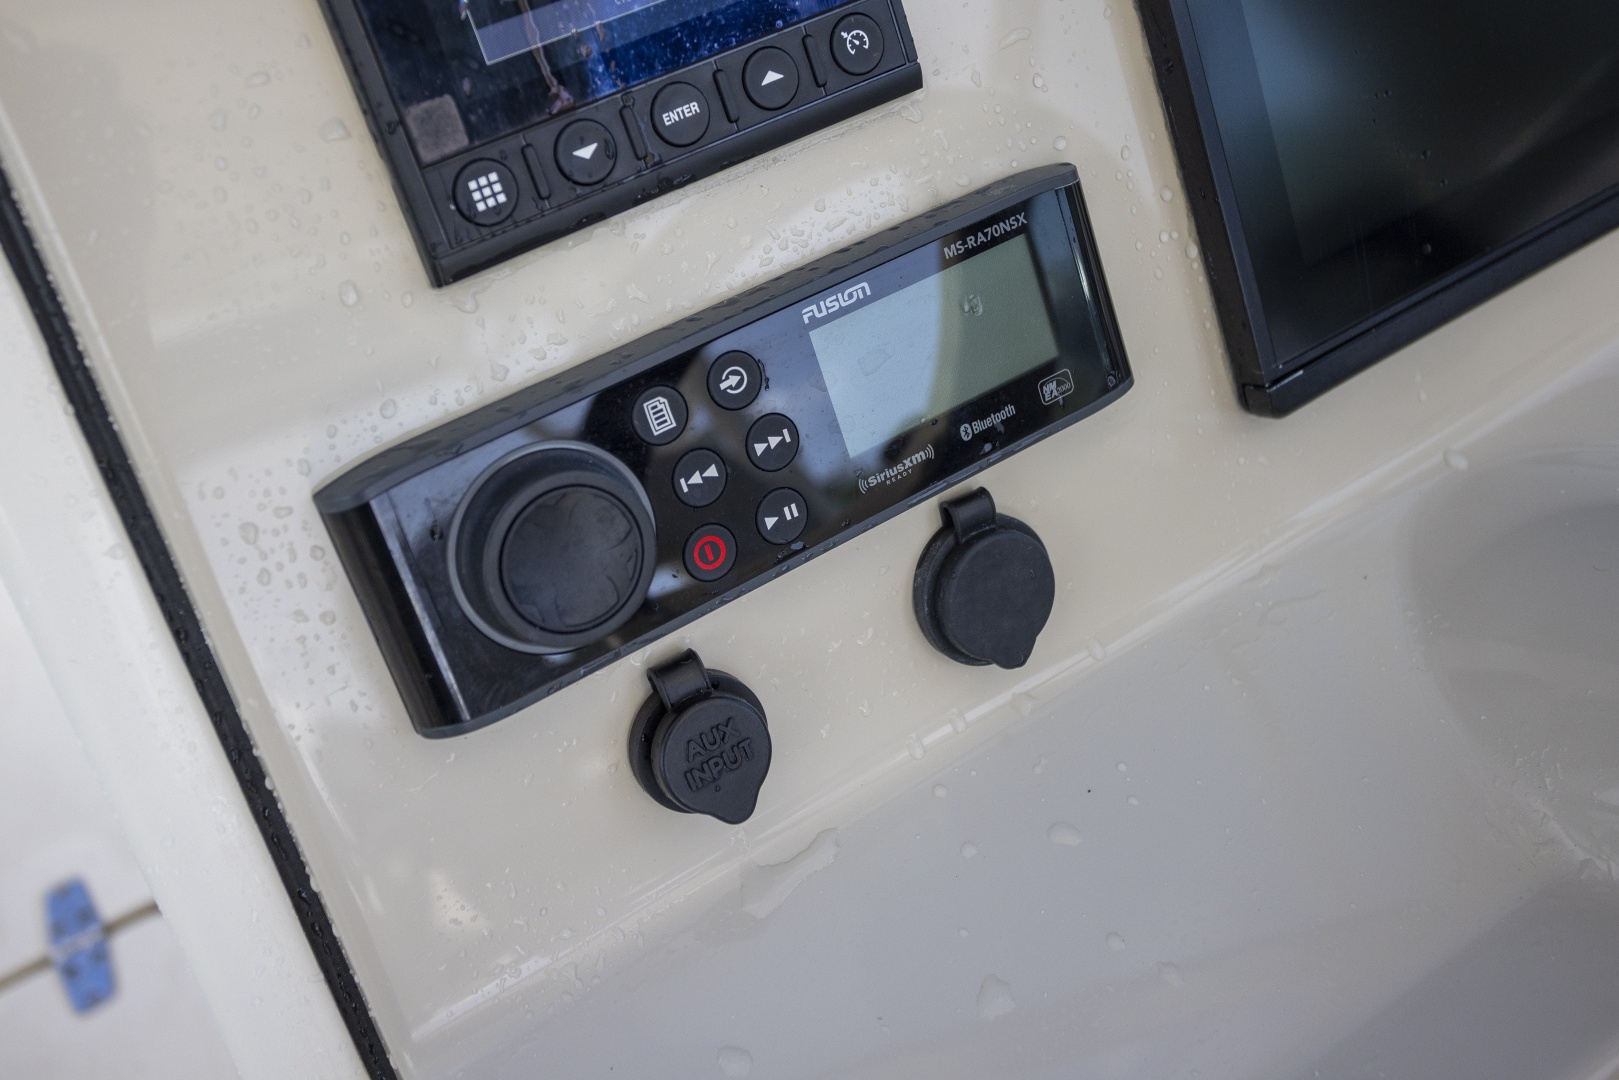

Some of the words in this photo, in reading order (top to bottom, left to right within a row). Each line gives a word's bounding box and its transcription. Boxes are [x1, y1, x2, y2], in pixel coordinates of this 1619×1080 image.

[662, 101, 700, 126] ENTER
[943, 212, 1028, 259] MS-RA70NSX
[971, 403, 1016, 435] Bluetooth
[886, 468, 912, 485] READY
[686, 717, 740, 763] AUX
[684, 738, 754, 792] INPUT
